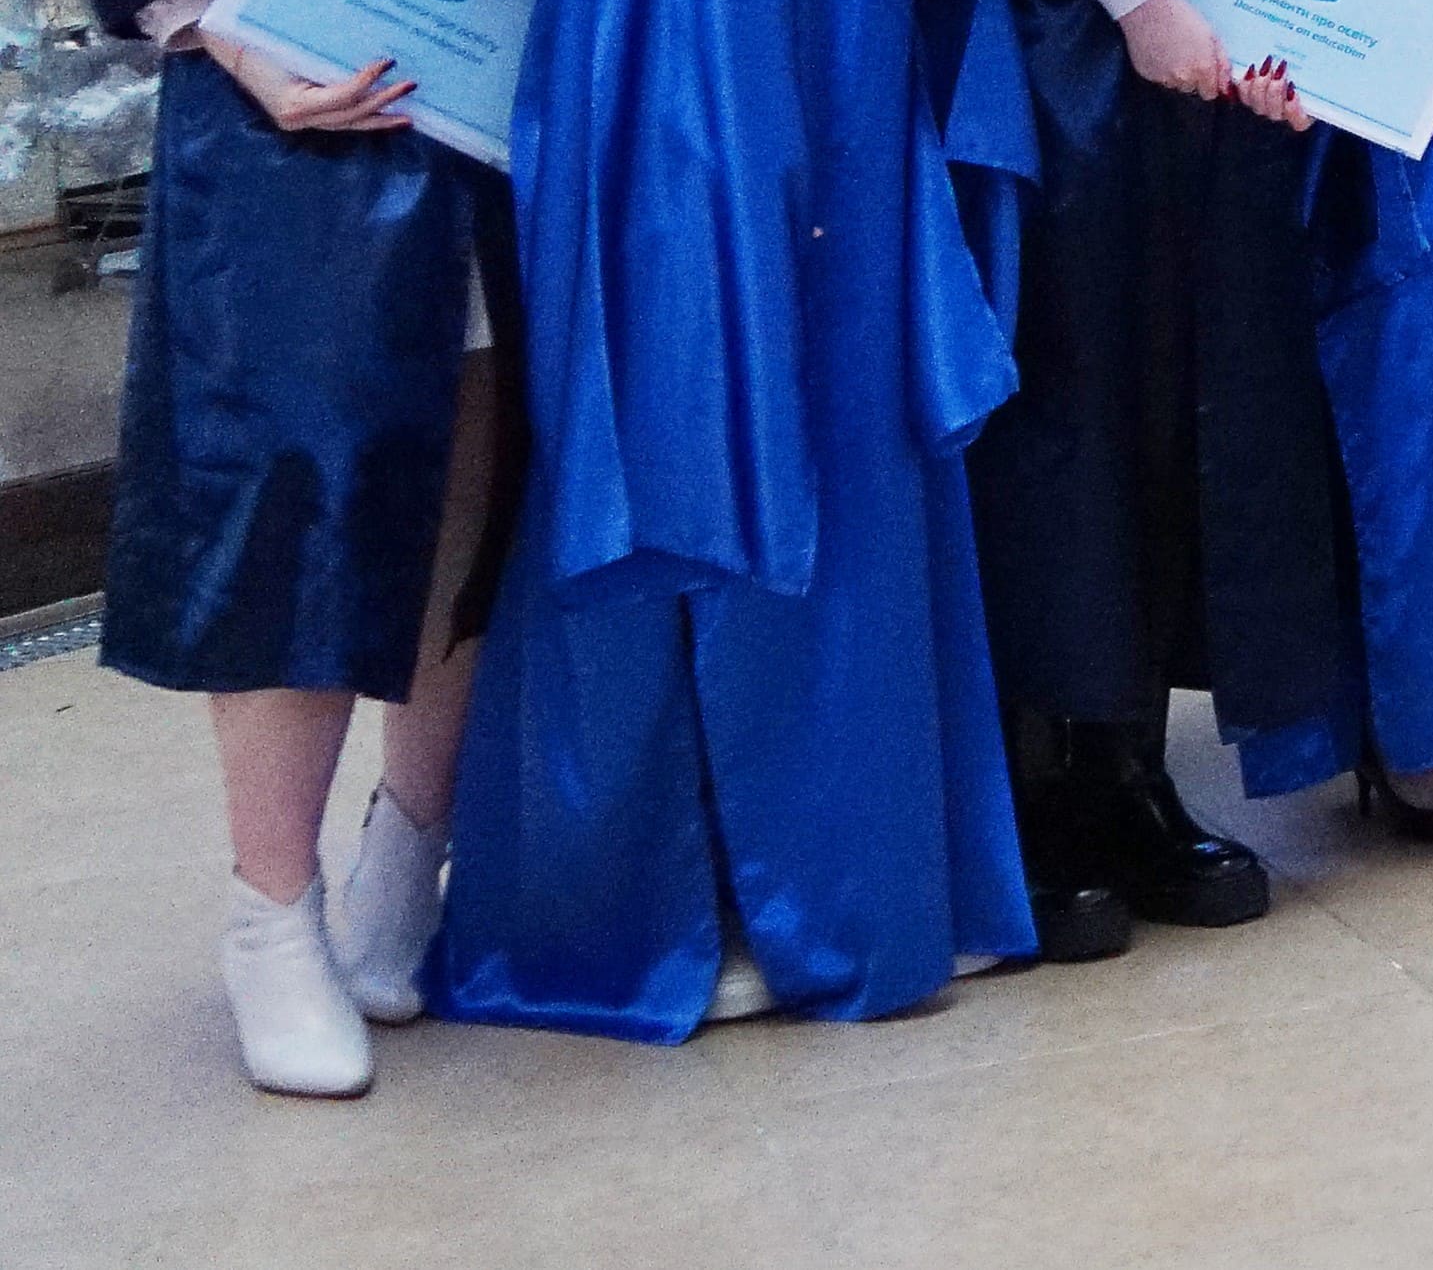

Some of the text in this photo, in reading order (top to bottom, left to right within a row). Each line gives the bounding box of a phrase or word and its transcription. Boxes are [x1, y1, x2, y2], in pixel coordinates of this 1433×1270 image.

[1233, 0, 1294, 32] Documents
[1295, 25, 1311, 39] on
[1312, 32, 1367, 60] education
[1312, 14, 1335, 31] про
[1337, 25, 1378, 49] освіту
